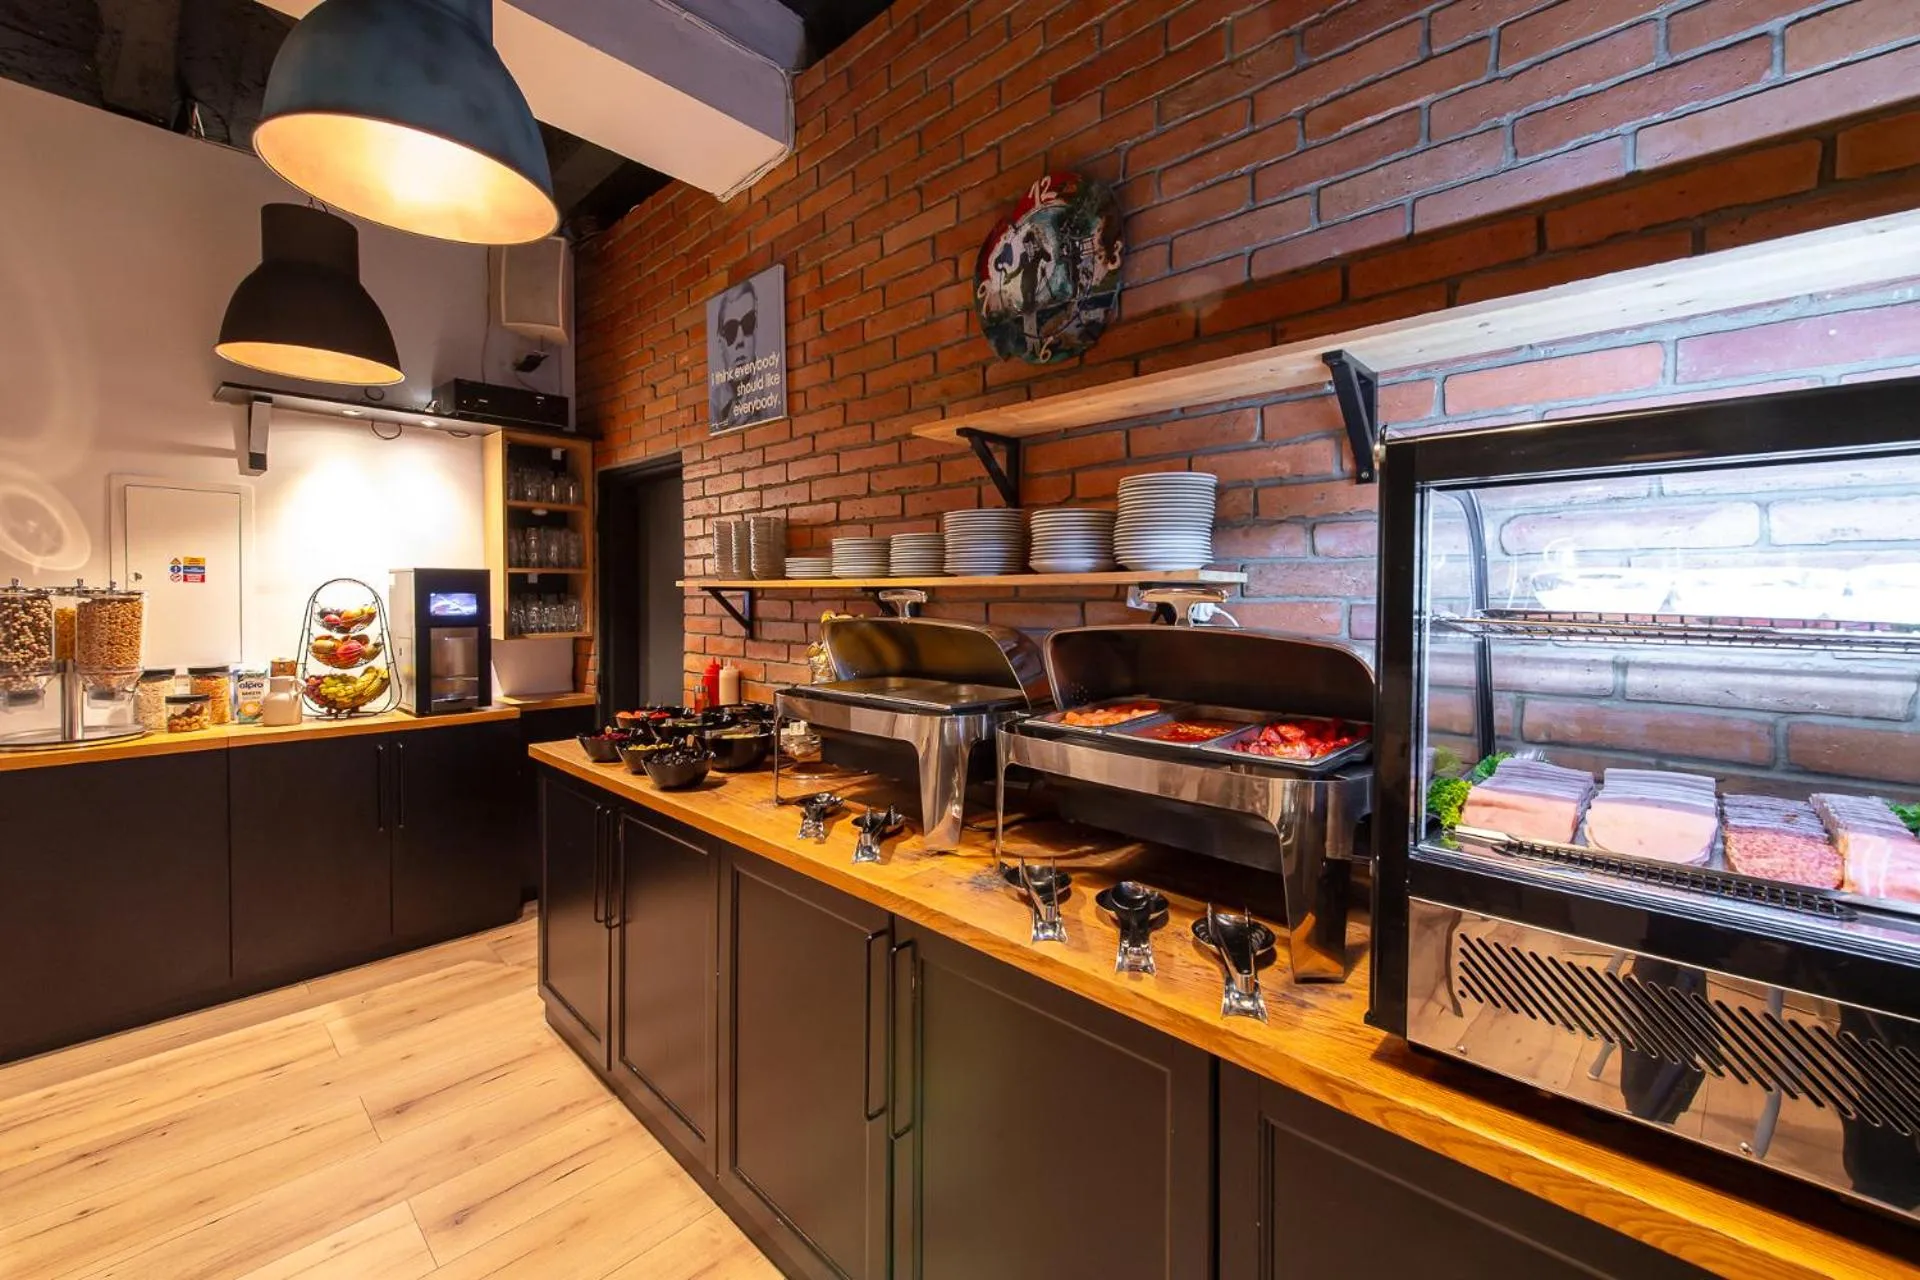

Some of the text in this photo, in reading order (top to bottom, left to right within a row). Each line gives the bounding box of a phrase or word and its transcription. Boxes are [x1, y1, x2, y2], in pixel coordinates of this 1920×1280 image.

[1028, 176, 1057, 208] 12
[1108, 240, 1123, 270] 3
[977, 281, 991, 318] 9
[1039, 335, 1053, 363] 6
[734, 351, 780, 378] everybody
[737, 373, 780, 396] should like
[732, 392, 781, 416] everybody.
[238, 681, 264, 690] alpro
